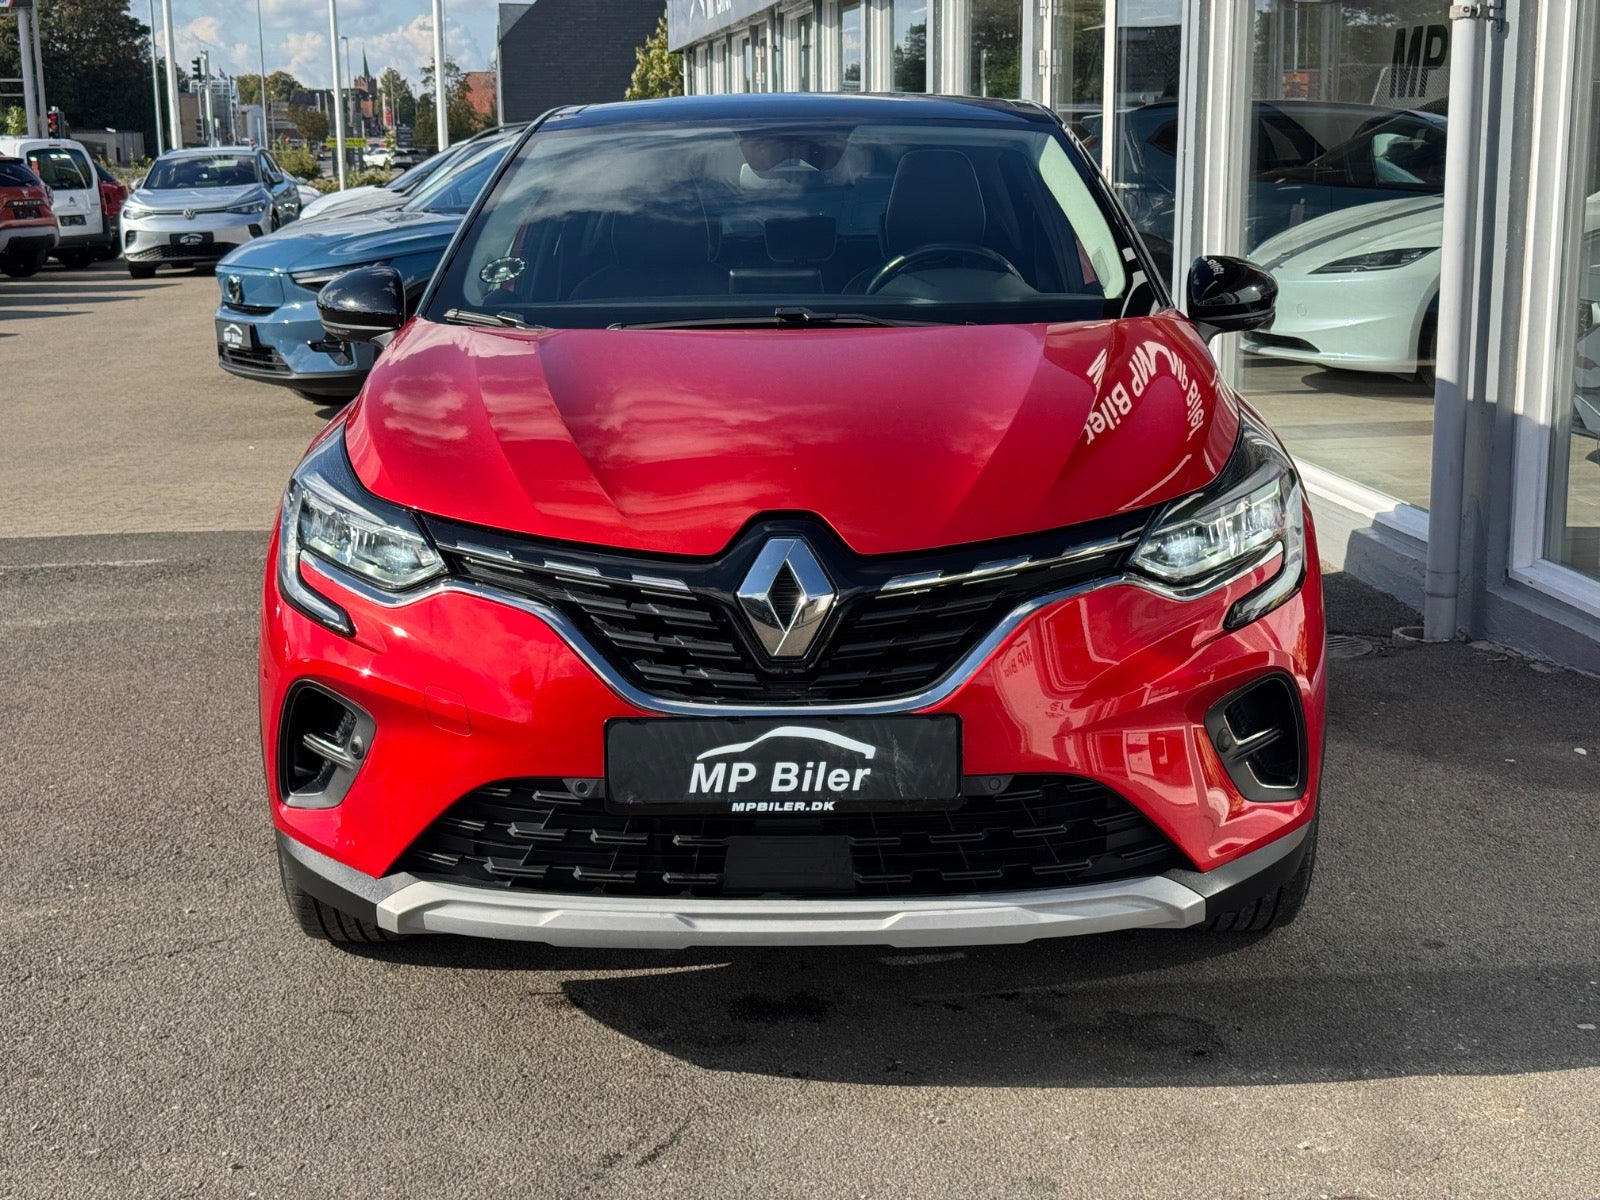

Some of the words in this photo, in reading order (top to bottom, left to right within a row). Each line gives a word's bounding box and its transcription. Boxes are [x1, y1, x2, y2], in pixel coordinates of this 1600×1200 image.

[1389, 24, 1449, 98] MP
[1084, 381, 1133, 445] Biler
[689, 762, 757, 794] MP
[770, 761, 872, 792] Biler
[732, 801, 836, 812] MPBILER.DK
